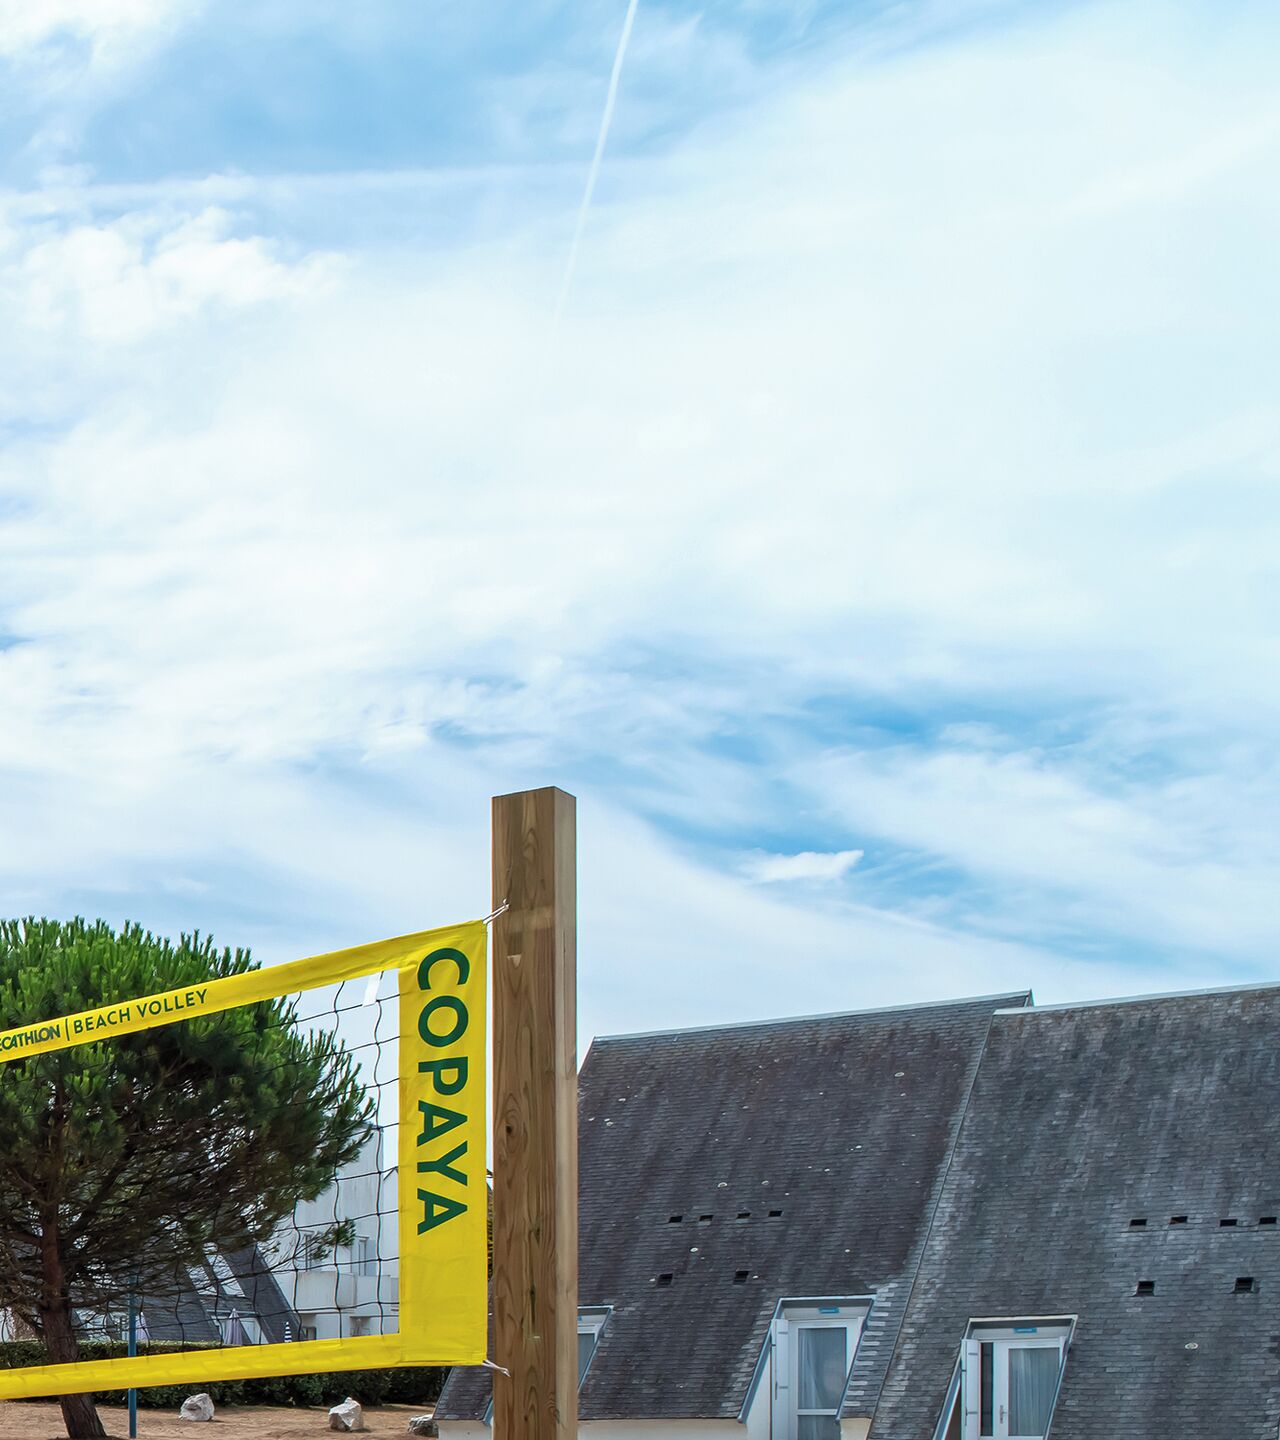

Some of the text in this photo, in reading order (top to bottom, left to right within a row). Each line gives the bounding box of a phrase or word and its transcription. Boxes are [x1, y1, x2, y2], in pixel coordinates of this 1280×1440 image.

[73, 1007, 131, 1034] BEACH
[136, 988, 208, 1018] VOLLEY
[416, 947, 471, 1236] COPAYA
